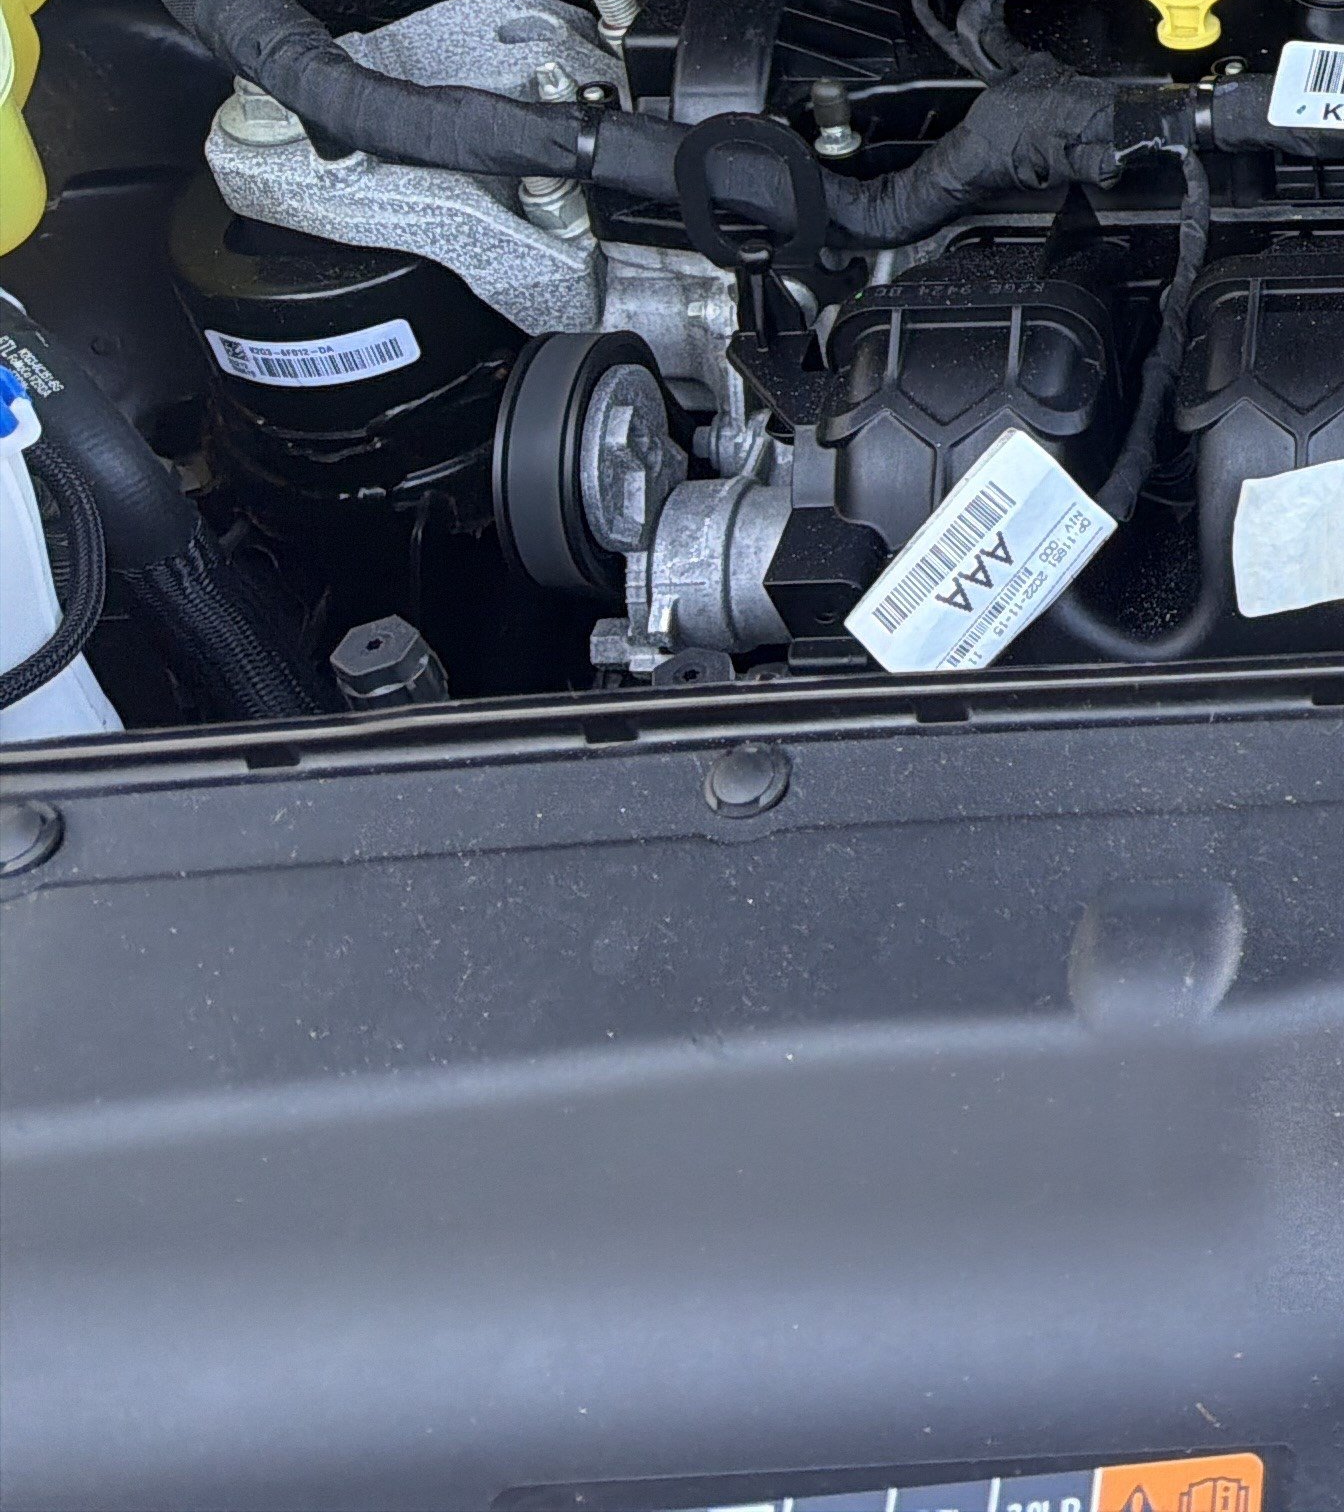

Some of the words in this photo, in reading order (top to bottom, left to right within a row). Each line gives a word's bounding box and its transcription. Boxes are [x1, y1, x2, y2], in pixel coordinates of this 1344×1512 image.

[1065, 510, 1084, 533] NIV
[935, 530, 1015, 614] AAA
[993, 569, 1048, 636] 2022-11-15
